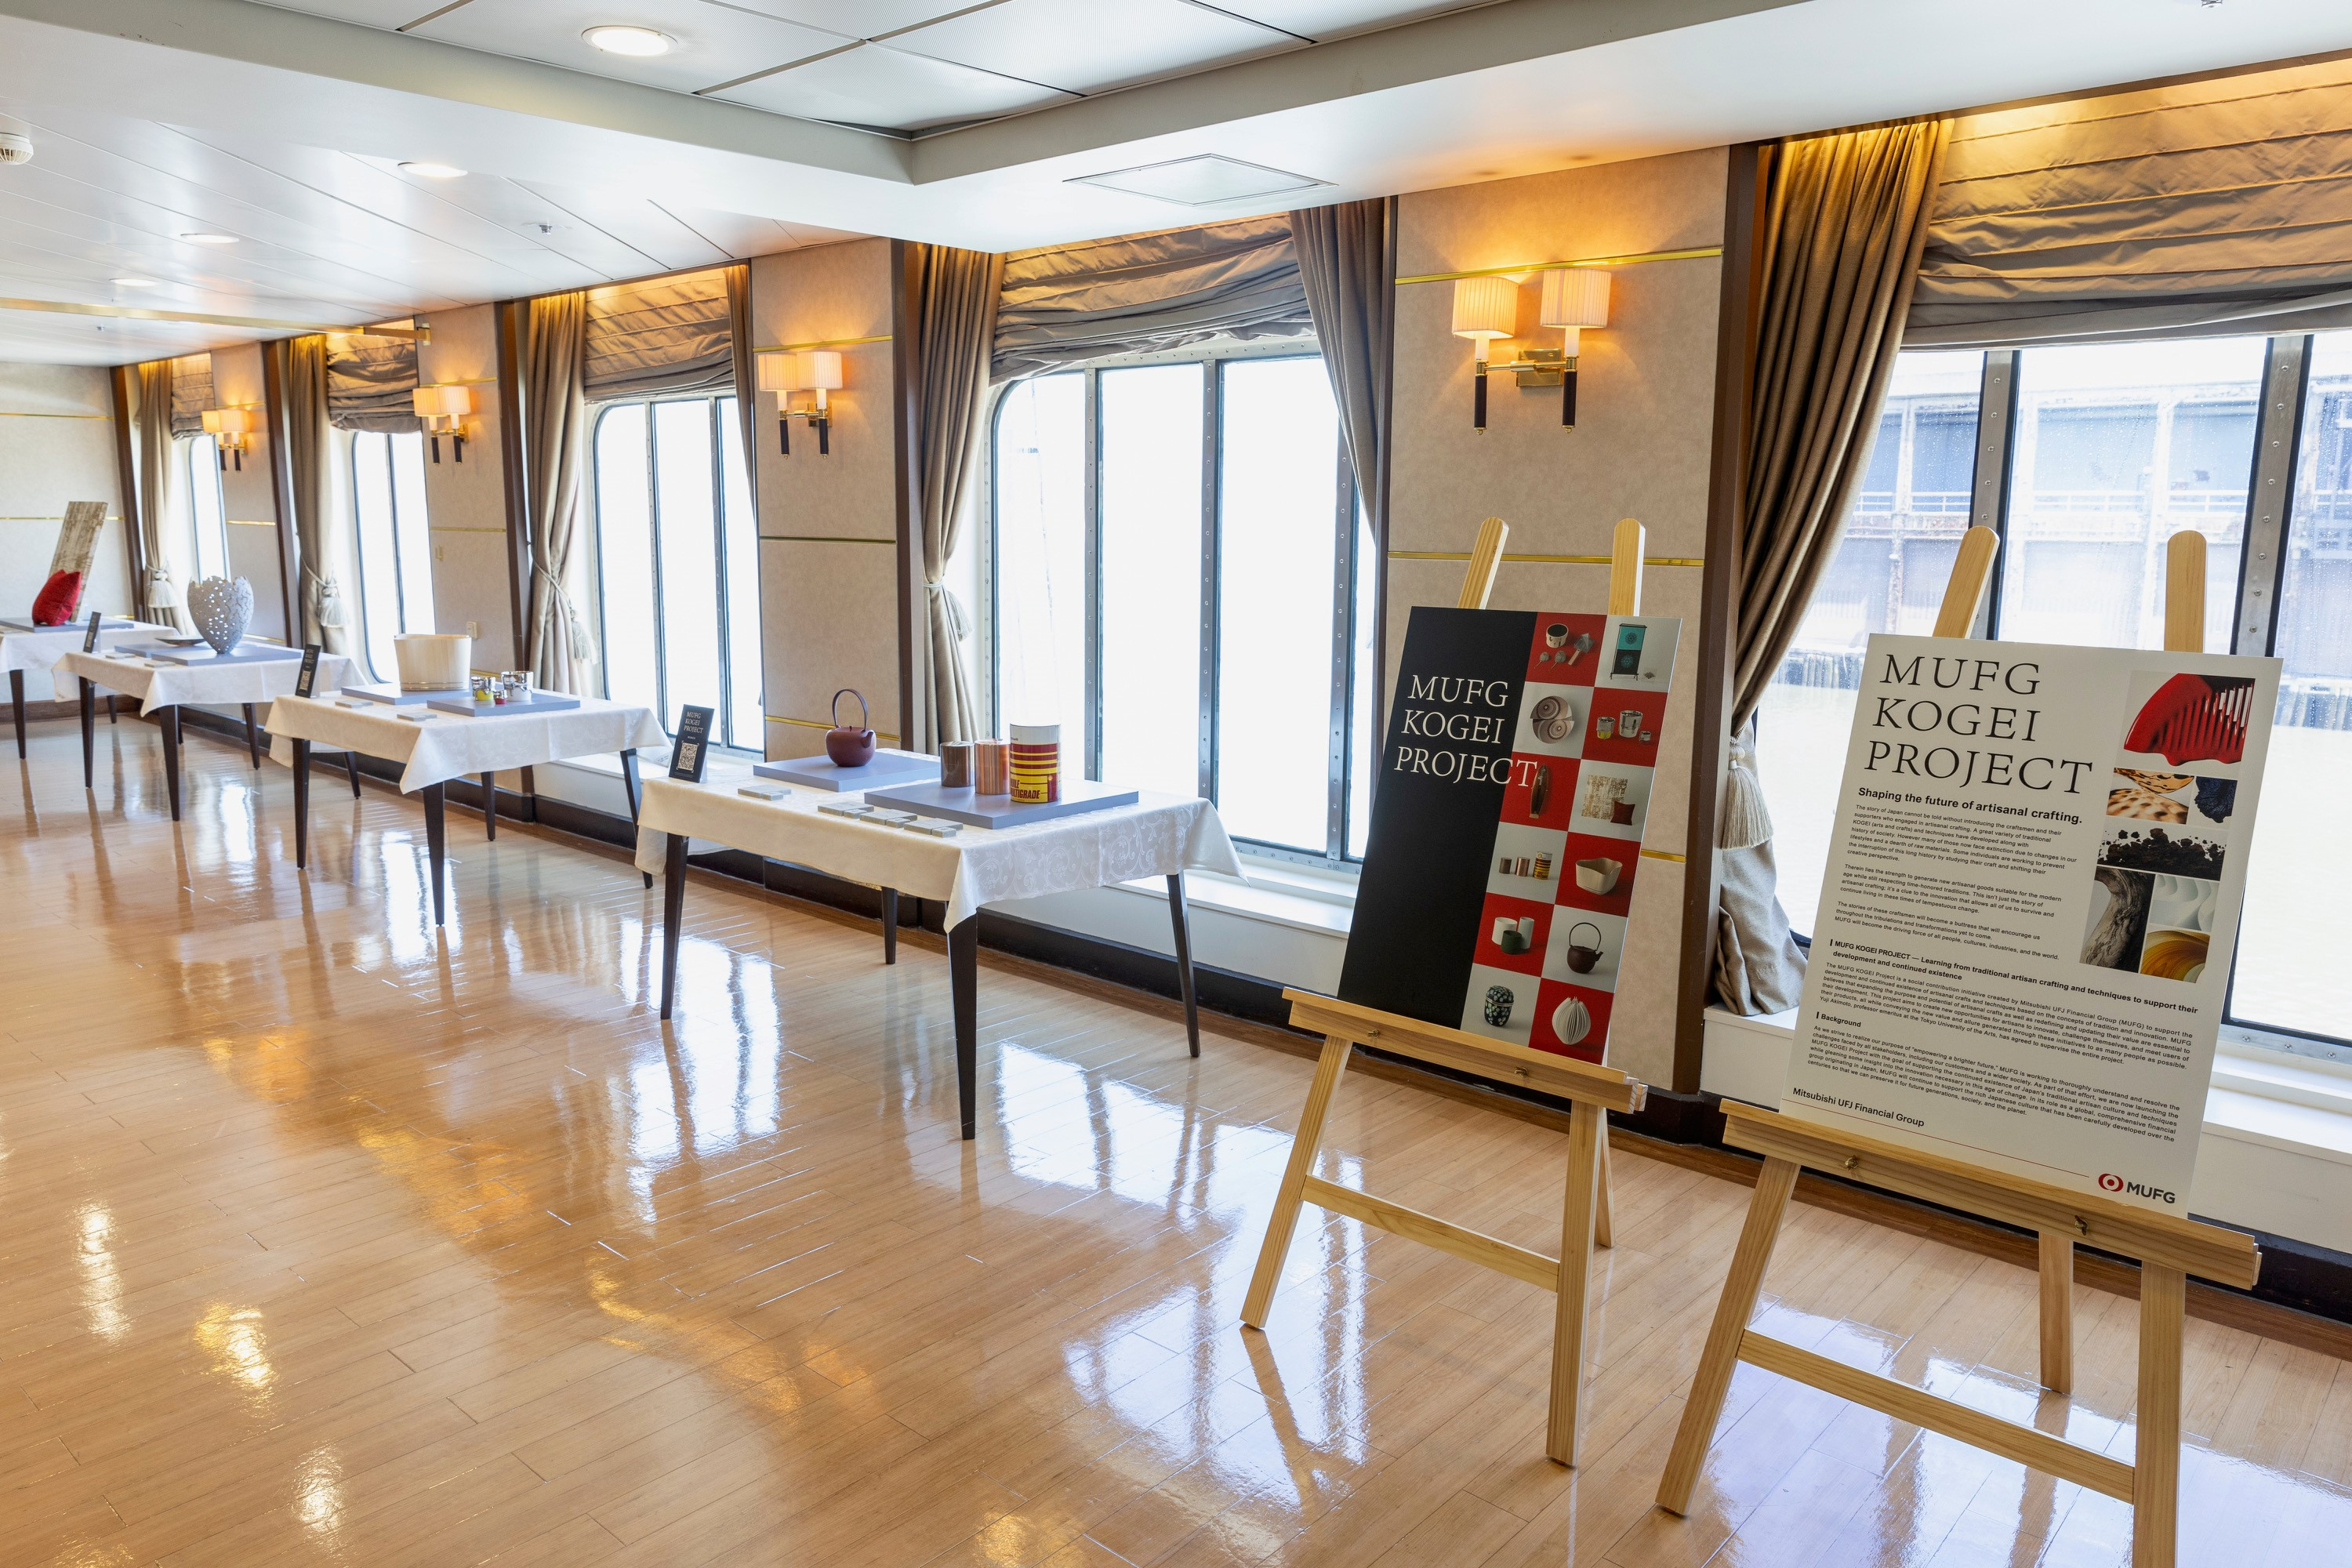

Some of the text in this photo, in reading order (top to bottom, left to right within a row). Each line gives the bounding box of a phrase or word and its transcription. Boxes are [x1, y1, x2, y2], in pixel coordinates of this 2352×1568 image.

[1879, 655, 2040, 695] MUFG
[1408, 675, 1508, 707] MUFG
[1401, 710, 1505, 744] KOGEI
[1872, 697, 2040, 742] KOGEI
[1393, 746, 1538, 787] PROJECT
[1864, 741, 2093, 793] PROJECT
[1858, 787, 2082, 825] Shaping the future of artisanal crafting.
[1963, 819, 1994, 828] introducing
[2022, 834, 2052, 843] traditional
[1868, 853, 1900, 862] perspective.
[1918, 851, 1937, 860] history
[1945, 856, 1969, 865] studying
[1969, 851, 2000, 860] individuals
[2034, 852, 2059, 861] changes
[1832, 950, 1876, 964] development
[1892, 963, 1927, 974] continued
[1928, 969, 1962, 981] existence
[1835, 941, 1854, 949] MUFG
[1855, 944, 1878, 954] KOGEI
[1878, 949, 1911, 960] PROJECT
[1921, 956, 1952, 969] Learning
[1954, 963, 1970, 971] from
[1972, 966, 2010, 978] traditional
[2011, 975, 2038, 984] artisan
[2038, 980, 2069, 991] crafting
[2087, 988, 2132, 1001] techniques
[2143, 999, 2176, 1010] support
[2178, 1004, 2198, 1014] their
[1855, 967, 1875, 976] KOGEI
[1875, 971, 1896, 980] Project
[1926, 982, 1960, 993] contribution
[1961, 989, 1986, 998] initiative
[1987, 994, 2010, 1003] created
[2020, 1000, 2051, 1011] Mitsubishi
[2066, 1009, 2096, 1019] Financial
[2096, 1014, 2117, 1024] Group
[2118, 1019, 2144, 1030] (MUFG)
[2154, 1027, 2180, 1036] support
[1820, 1013, 1861, 1028] Background
[1807, 1060, 1831, 1069] centuries
[1870, 1074, 1894, 1083] preserve
[1792, 1087, 1925, 1127] Mitsubishi UFJ Financial Group
[2127, 1181, 2175, 1204] MUFG
